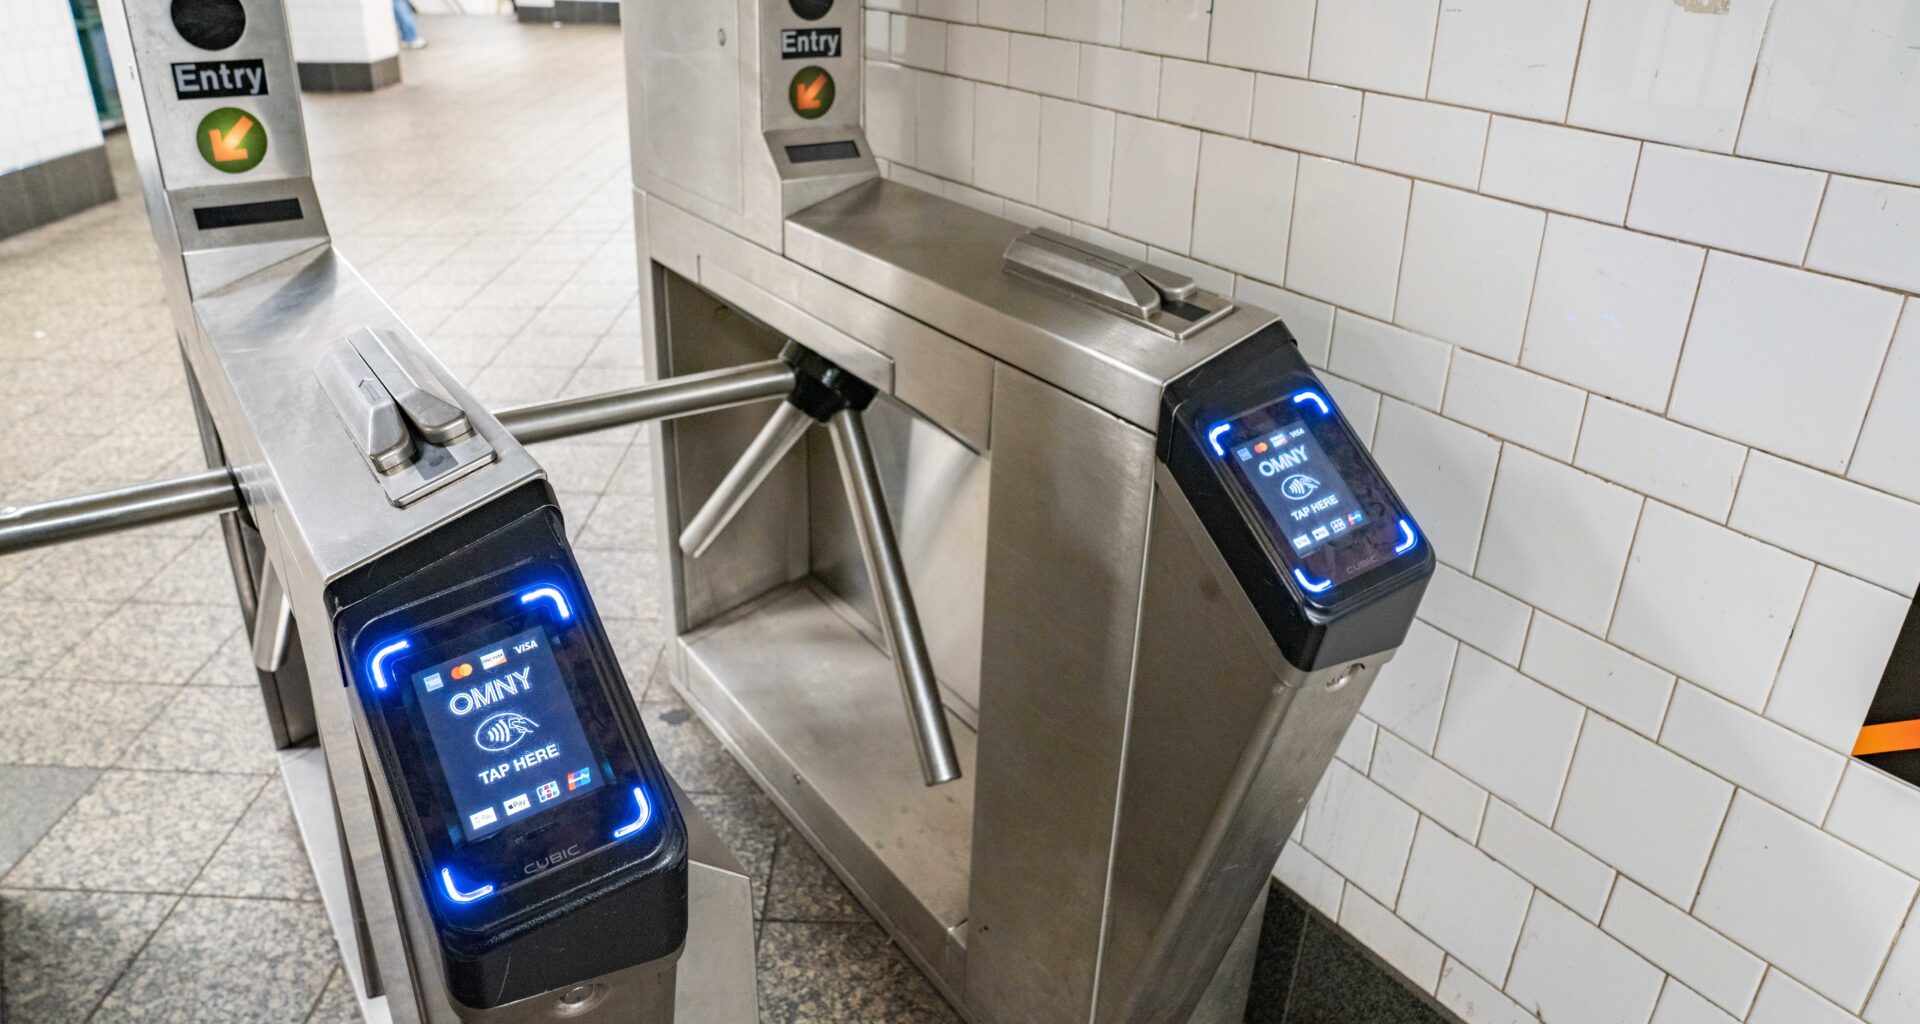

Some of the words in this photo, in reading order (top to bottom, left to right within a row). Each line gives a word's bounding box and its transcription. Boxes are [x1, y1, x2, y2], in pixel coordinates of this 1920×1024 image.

[782, 31, 839, 56] Entry
[174, 63, 262, 95] Entry
[1289, 427, 1305, 438] VISA
[1258, 444, 1308, 477] OMNY
[1290, 507, 1310, 521] TAP
[1312, 495, 1338, 513] HERE
[513, 640, 538, 654] VISA
[449, 666, 531, 715] OMNY
[478, 763, 510, 785] TAP
[513, 743, 560, 772] HERE
[512, 799, 526, 809] Pay
[523, 844, 581, 875] CUBIC
